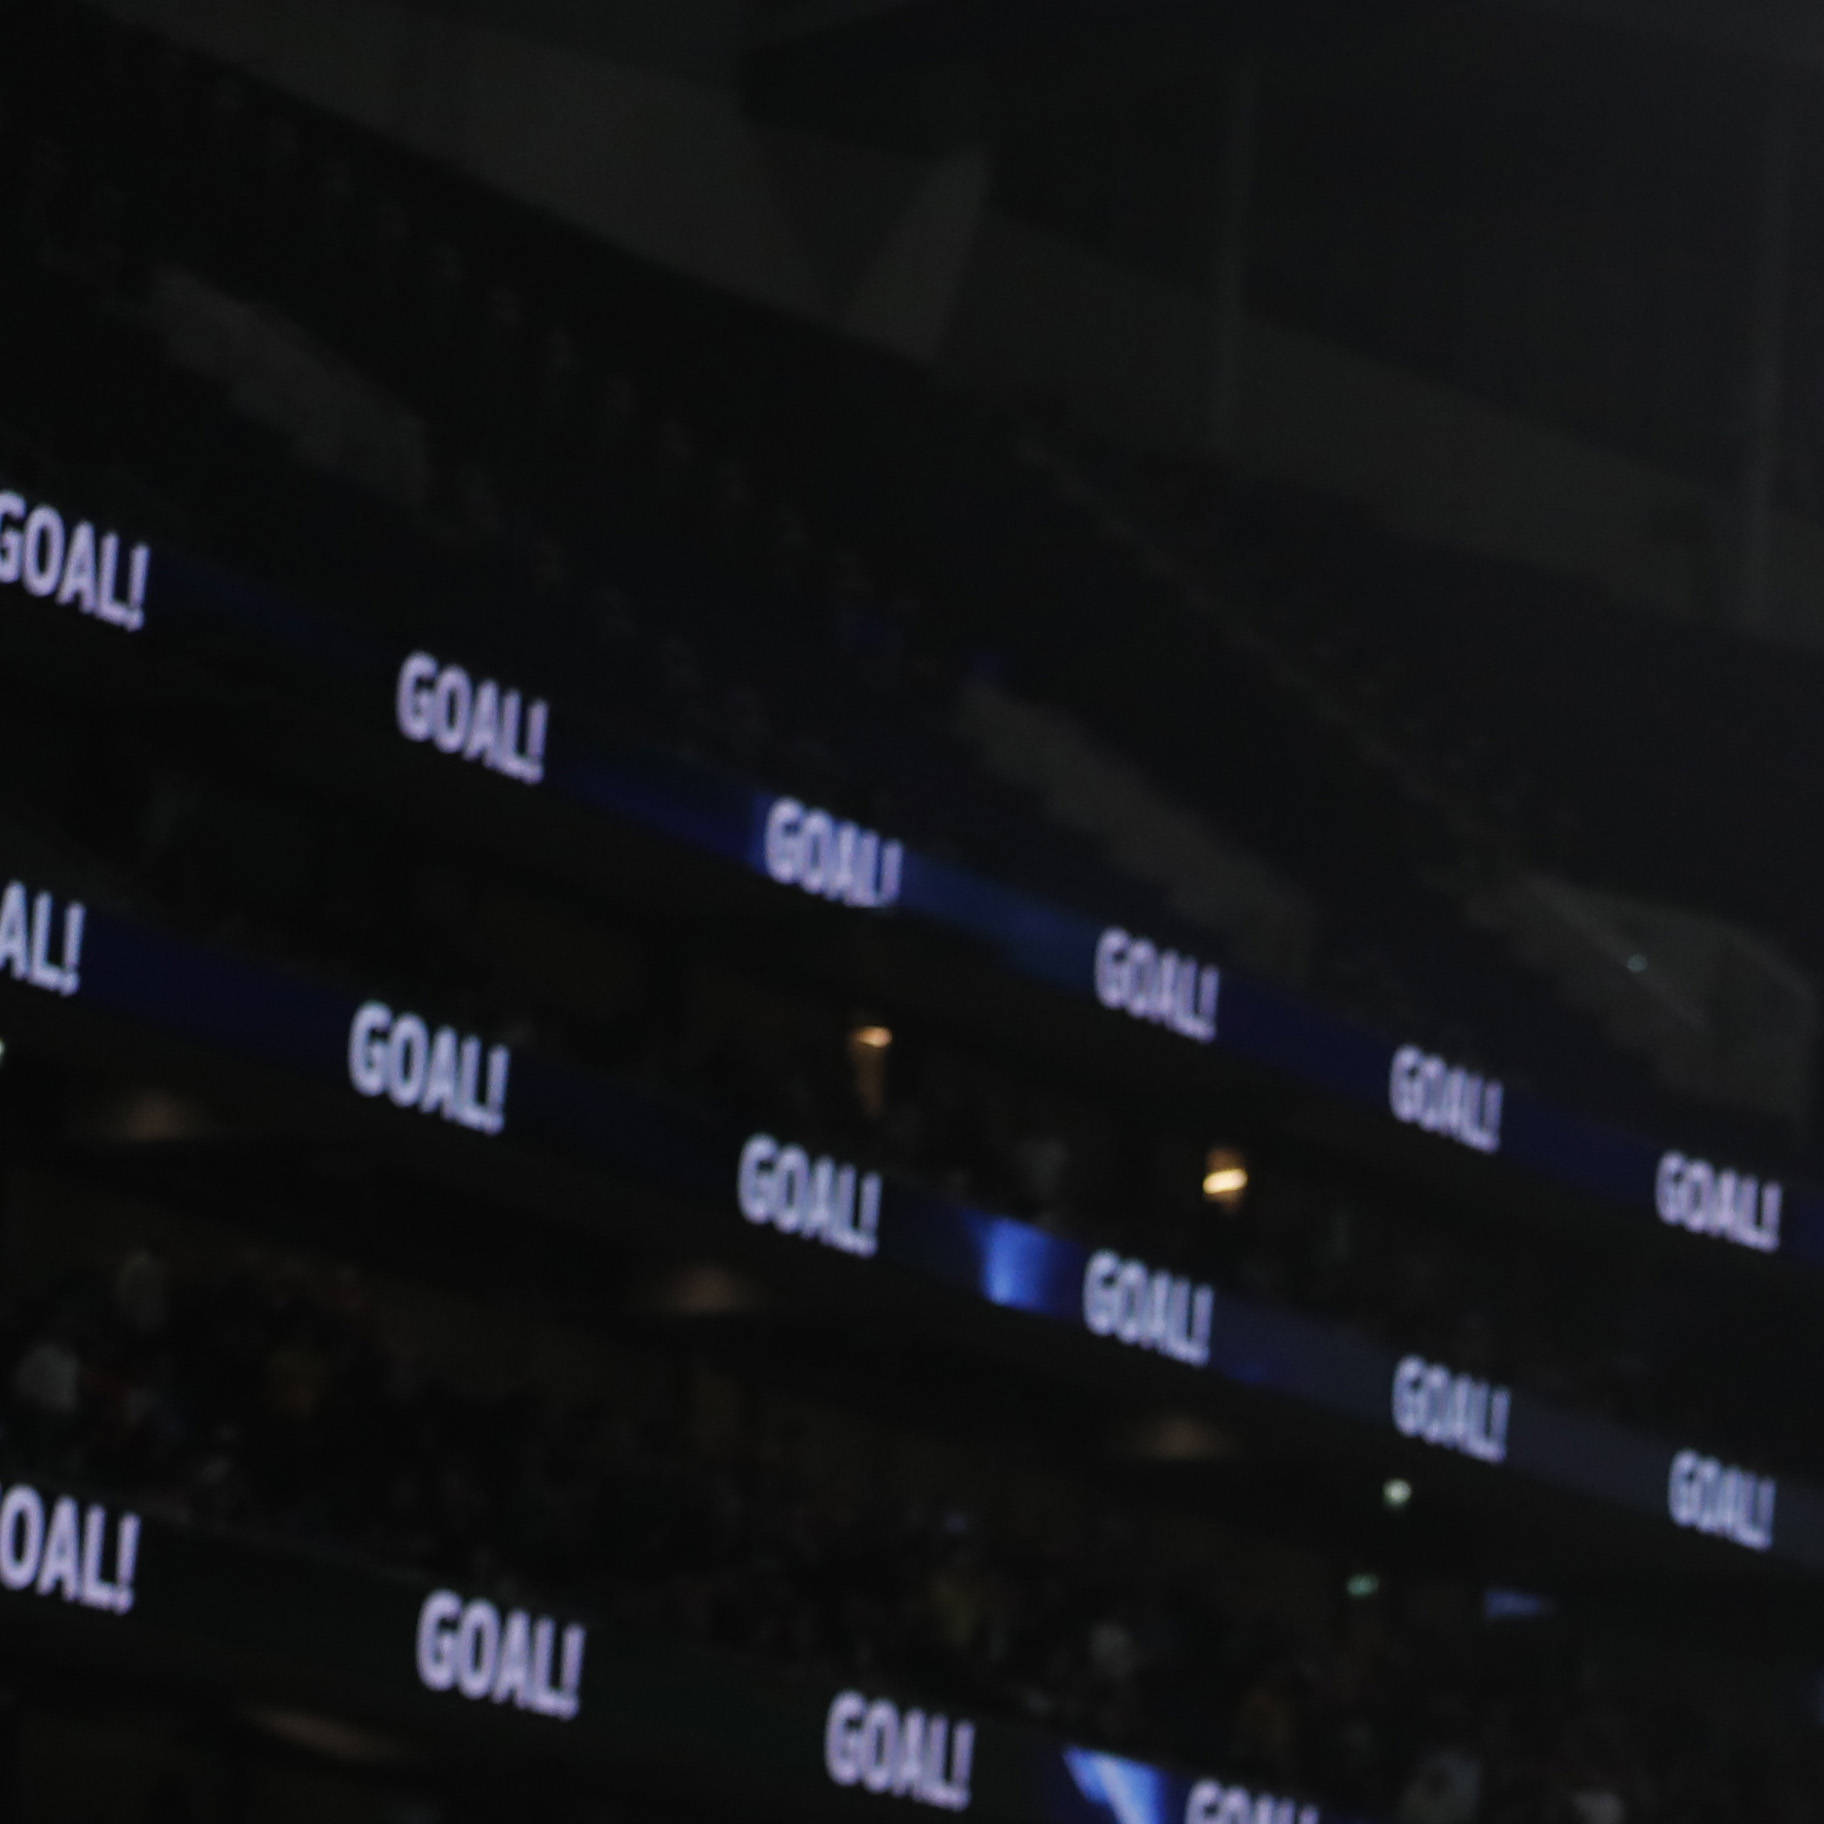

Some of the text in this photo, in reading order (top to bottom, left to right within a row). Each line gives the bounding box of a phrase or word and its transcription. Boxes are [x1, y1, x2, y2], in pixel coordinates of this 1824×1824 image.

[398, 653, 546, 782] GOAL!
[766, 799, 901, 906] GOAL!
[1096, 930, 1217, 1039] GOAL!
[350, 1005, 507, 1131] GOAL!
[1391, 1047, 1500, 1150] GOAL!
[739, 1136, 879, 1254] GOAL!
[1657, 1154, 1780, 1250] GOAL!
[1084, 1252, 1211, 1363] GOAL!
[1394, 1358, 1507, 1461] GOAL!
[1670, 1451, 1773, 1548] GOAL!
[418, 1592, 583, 1717] GOAL!
[826, 1693, 973, 1808] GOAL!
